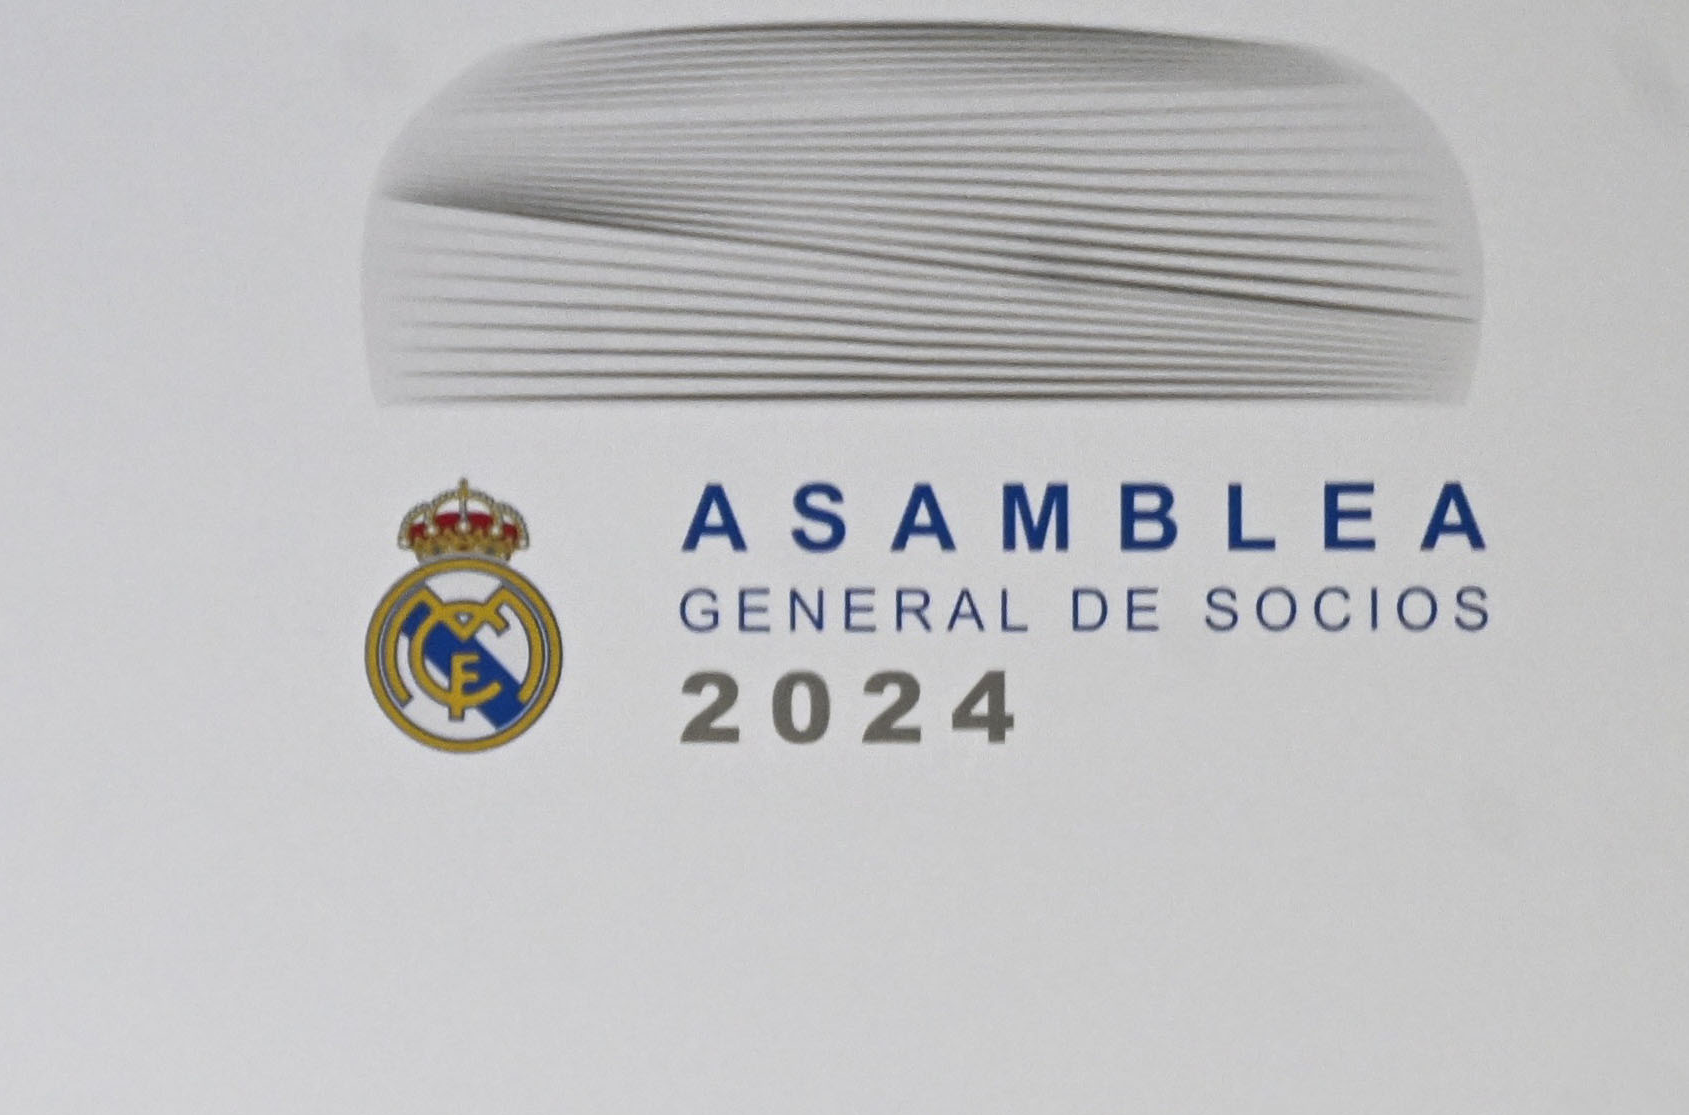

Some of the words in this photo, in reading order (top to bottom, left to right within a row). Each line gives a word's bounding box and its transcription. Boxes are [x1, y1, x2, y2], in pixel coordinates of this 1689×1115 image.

[681, 480, 1487, 554] ASAMBLEA
[679, 587, 1029, 634] GENERAL
[1071, 587, 1161, 633] DE
[1204, 585, 1490, 633] SOCIOS
[680, 670, 1015, 745] 2024
